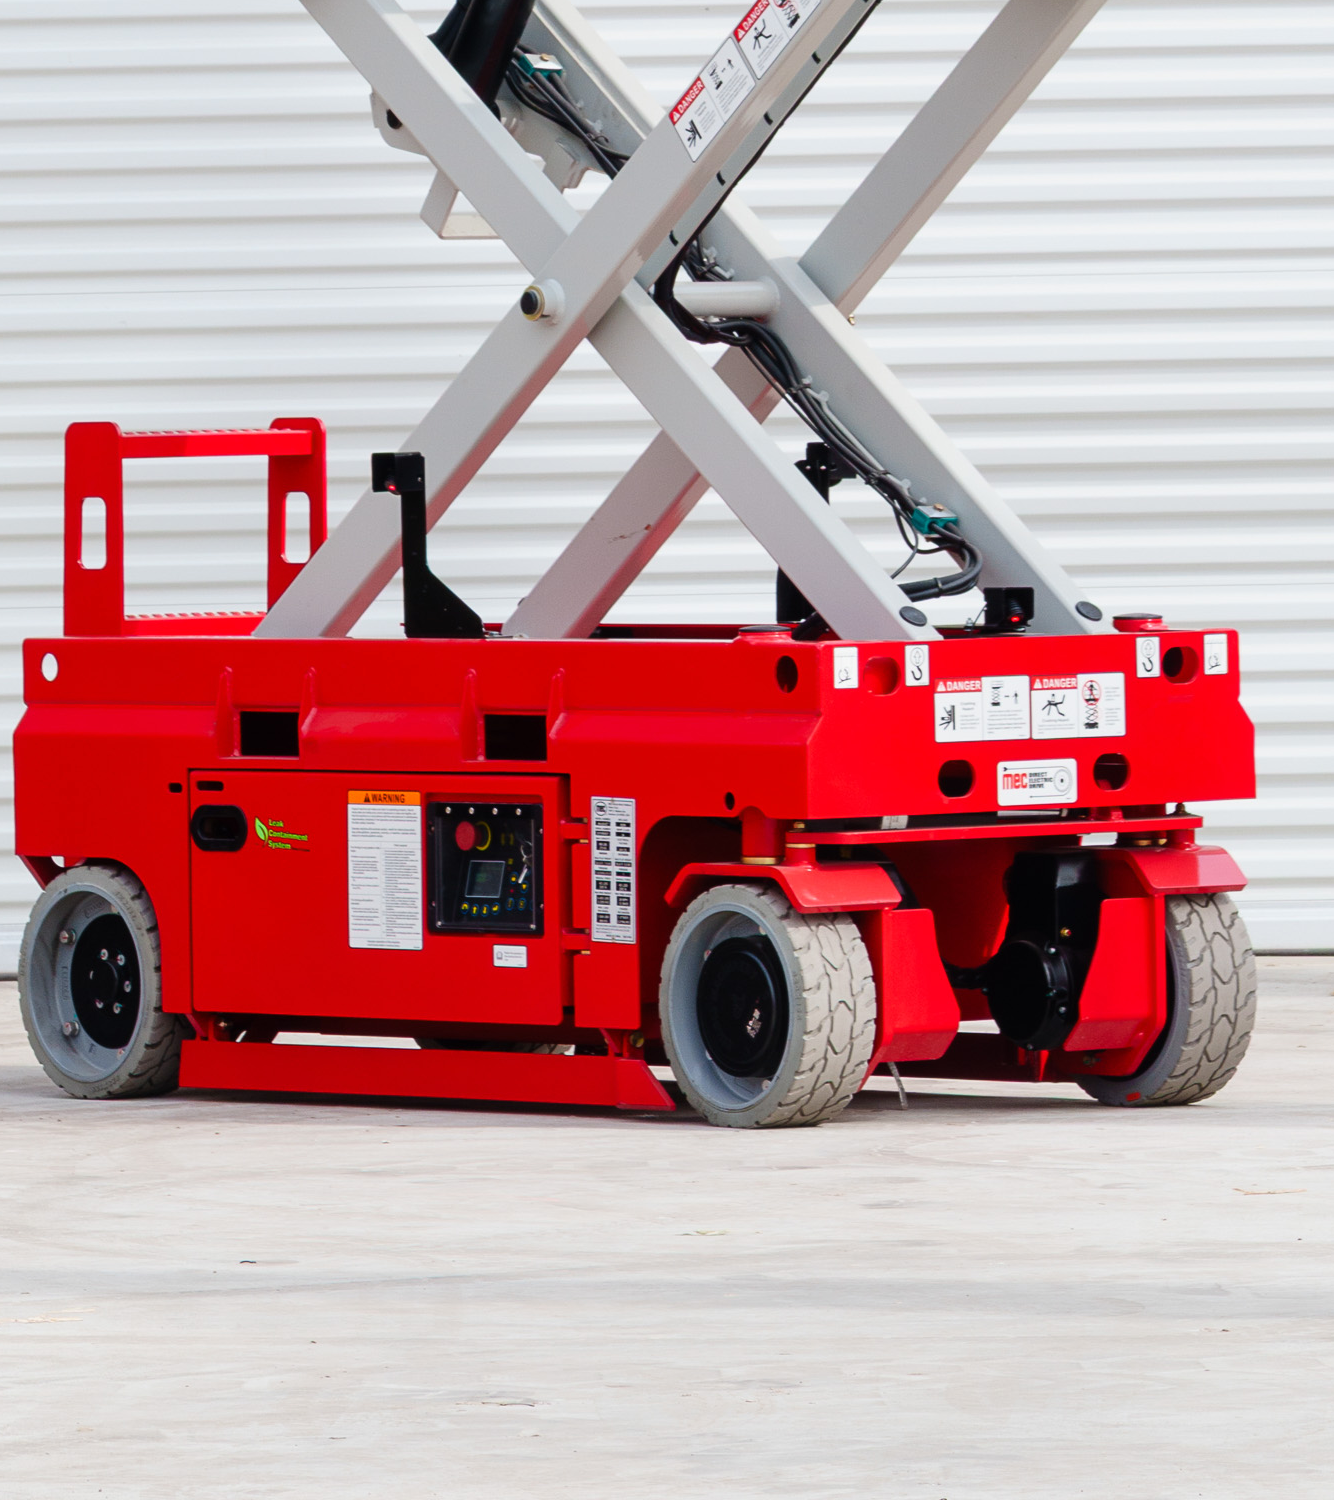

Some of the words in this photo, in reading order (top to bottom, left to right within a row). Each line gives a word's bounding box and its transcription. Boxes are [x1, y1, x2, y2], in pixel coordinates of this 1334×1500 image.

[677, 81, 704, 114] DANGER
[946, 680, 981, 691] DANGER
[1043, 678, 1077, 688] DANGER
[1003, 773, 1027, 790] mec
[371, 794, 405, 803] WARNING
[269, 818, 284, 827] Leak
[269, 830, 308, 841] Containment
[268, 840, 291, 849] System
